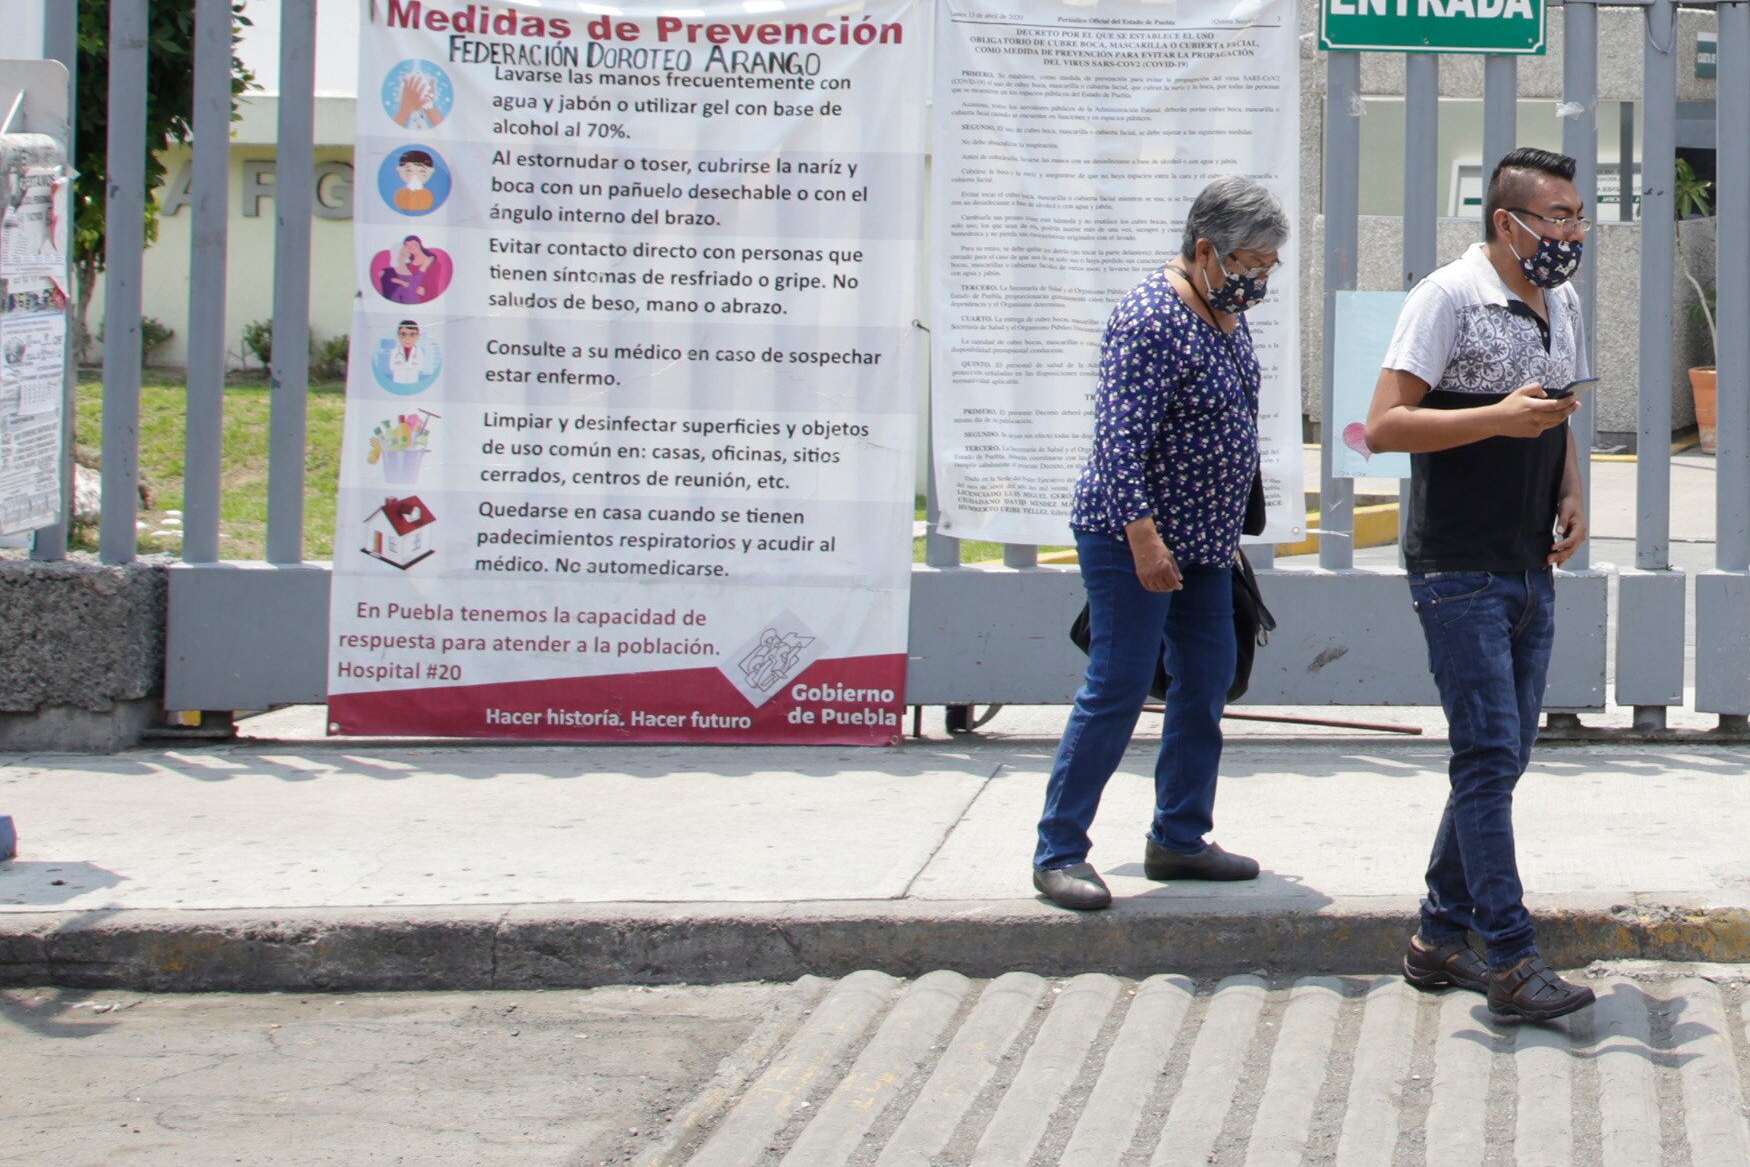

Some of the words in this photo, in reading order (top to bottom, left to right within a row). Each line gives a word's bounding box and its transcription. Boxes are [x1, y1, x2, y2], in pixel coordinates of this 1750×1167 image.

[586, 14, 640, 40] de
[656, 15, 902, 45] Prevención
[448, 34, 578, 68] FEDERACIÓN
[586, 40, 692, 72] DOROTEO
[704, 45, 821, 77] ARANGO
[494, 65, 562, 83] Lavarse
[568, 67, 594, 85] las
[598, 73, 660, 87] manos
[666, 69, 814, 91] frecuentemente
[820, 75, 852, 91] con
[492, 95, 537, 111] agua
[542, 97, 554, 112] y
[557, 94, 611, 113] jabón
[616, 100, 628, 111] o
[634, 97, 698, 113] utilizar
[702, 99, 729, 118] gel
[734, 103, 767, 115] con
[773, 100, 814, 116] base
[819, 100, 842, 116] de
[492, 118, 558, 136] alcohol
[564, 121, 580, 136] al
[587, 122, 630, 138] 70%.
[491, 149, 510, 165] Al
[516, 153, 619, 169] estornudar
[623, 158, 635, 170] o
[640, 157, 691, 174] toser,
[697, 157, 770, 173] cubrirse
[776, 157, 791, 173] la
[847, 163, 858, 178] y
[491, 176, 534, 193] boca
[540, 182, 573, 194] con
[579, 184, 602, 195] un
[608, 181, 682, 199] pañuelo
[687, 183, 791, 200] desechable
[796, 189, 808, 200] o
[814, 189, 846, 201] con
[851, 185, 867, 201] el
[489, 203, 552, 223] ángulo
[558, 206, 625, 223] interno
[630, 208, 658, 224] del
[665, 209, 720, 225] brazo.
[486, 339, 566, 357] Consulte
[571, 346, 582, 357] a
[588, 346, 608, 358] su
[614, 343, 682, 360] médico
[687, 349, 709, 360] en
[715, 349, 756, 362] caso
[760, 346, 783, 363] de
[788, 348, 882, 366] sospechar
[484, 368, 532, 382] estar
[536, 368, 620, 385] enfermo.
[474, 555, 548, 572] médico.
[555, 557, 581, 573] No
[586, 559, 729, 576] automedicarse.
[356, 601, 380, 618] En
[387, 602, 453, 620] Puebla
[460, 606, 547, 622] tenemos
[553, 605, 570, 623] la
[576, 608, 676, 627] capacidad
[682, 609, 706, 626] de
[339, 634, 435, 651] respuesta
[441, 637, 486, 653] para
[492, 635, 571, 652] atender
[576, 640, 587, 652] a
[594, 635, 610, 653] la
[617, 637, 720, 657] población.
[337, 661, 420, 681] Hospital
[426, 661, 464, 683] #20
[790, 683, 896, 705] Gobierno
[486, 708, 542, 724] Hacer
[630, 710, 686, 727] Hacer
[690, 710, 751, 728] futuro
[787, 706, 814, 724] de
[821, 707, 896, 725] Puebla
